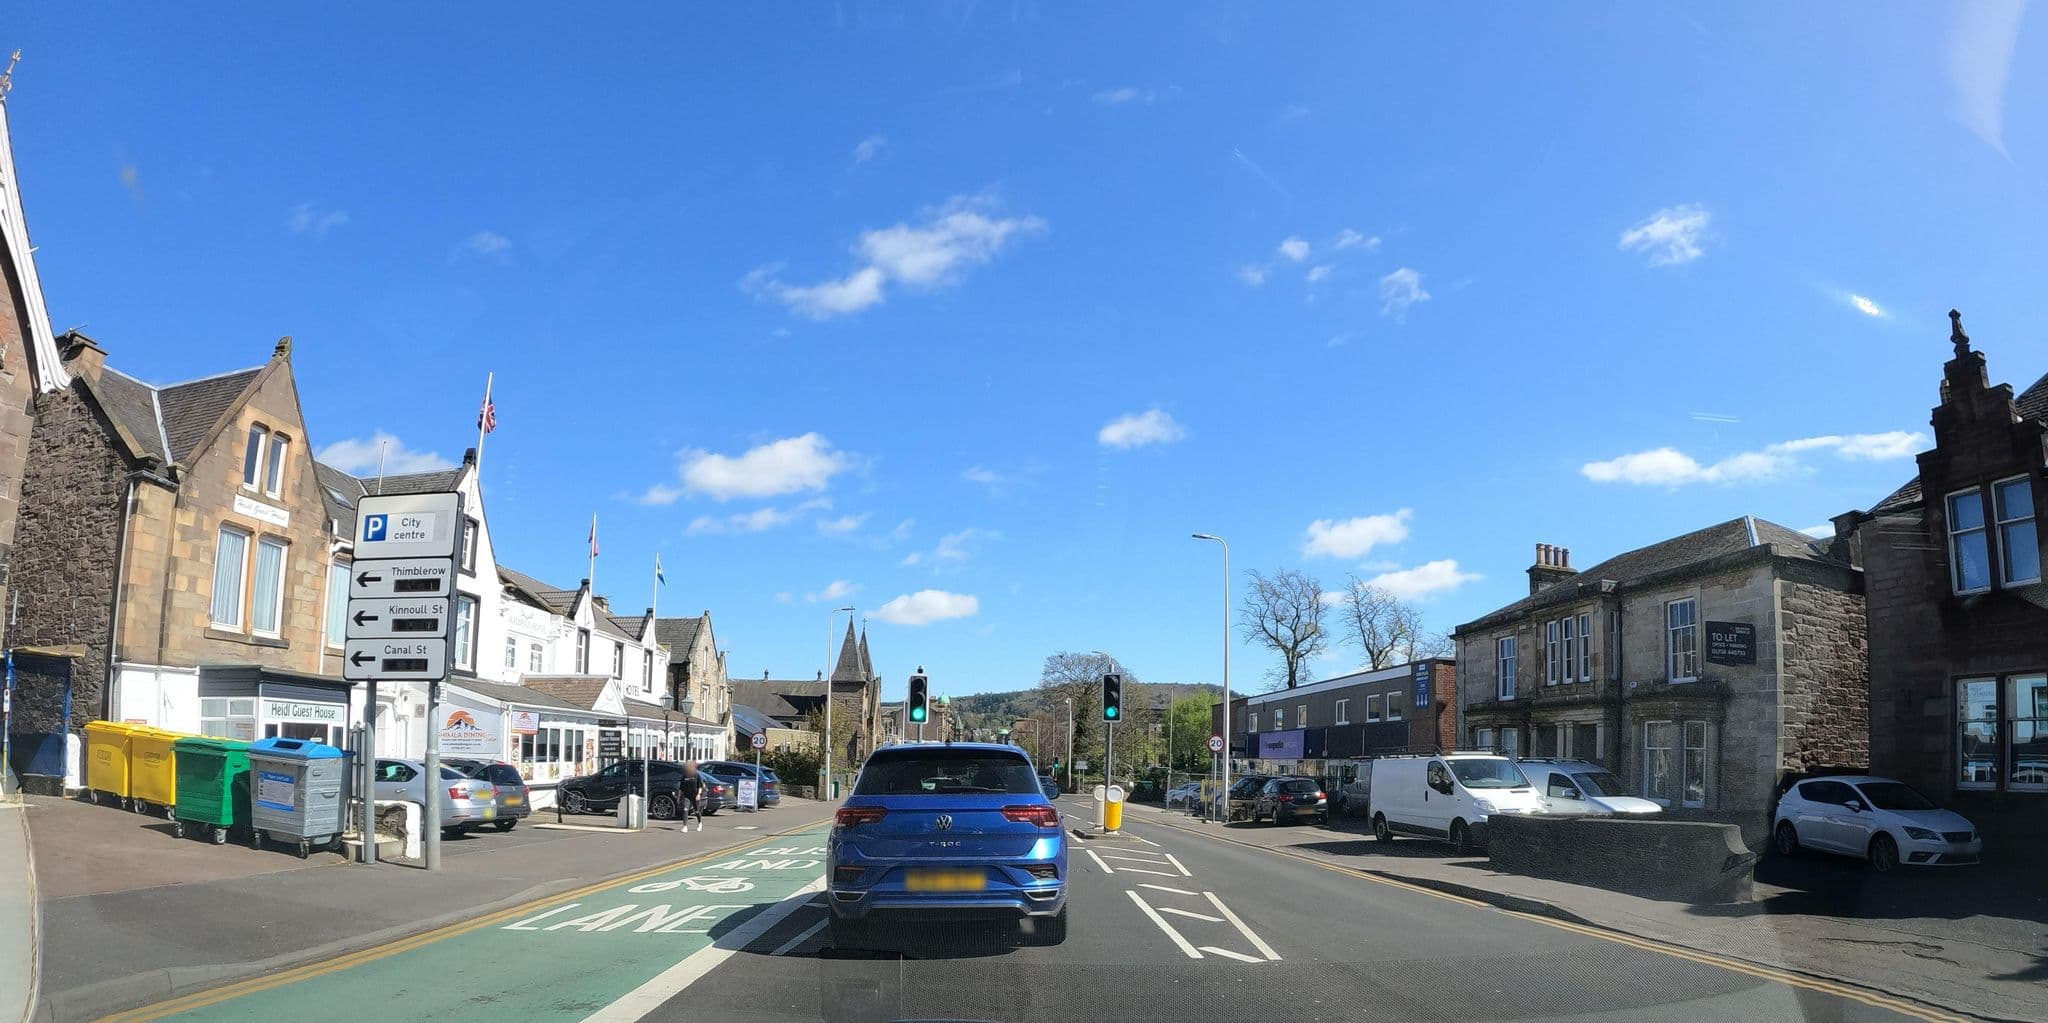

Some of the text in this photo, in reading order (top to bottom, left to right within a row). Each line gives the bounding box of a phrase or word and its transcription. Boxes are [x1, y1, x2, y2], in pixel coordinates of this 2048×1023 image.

[367, 517, 383, 540] P
[401, 517, 422, 531] City
[394, 531, 425, 540] centre
[391, 565, 446, 576] Thimblerow
[389, 604, 444, 615] Kinnoull St
[1711, 632, 1737, 642] TO LET
[384, 645, 427, 655] Canal St
[292, 704, 312, 718] Guest
[314, 706, 336, 719] House
[753, 737, 765, 745] 20
[1211, 739, 1221, 747] 20
[744, 847, 827, 856] BUS
[700, 859, 819, 870] AND
[501, 903, 754, 933] LANE
